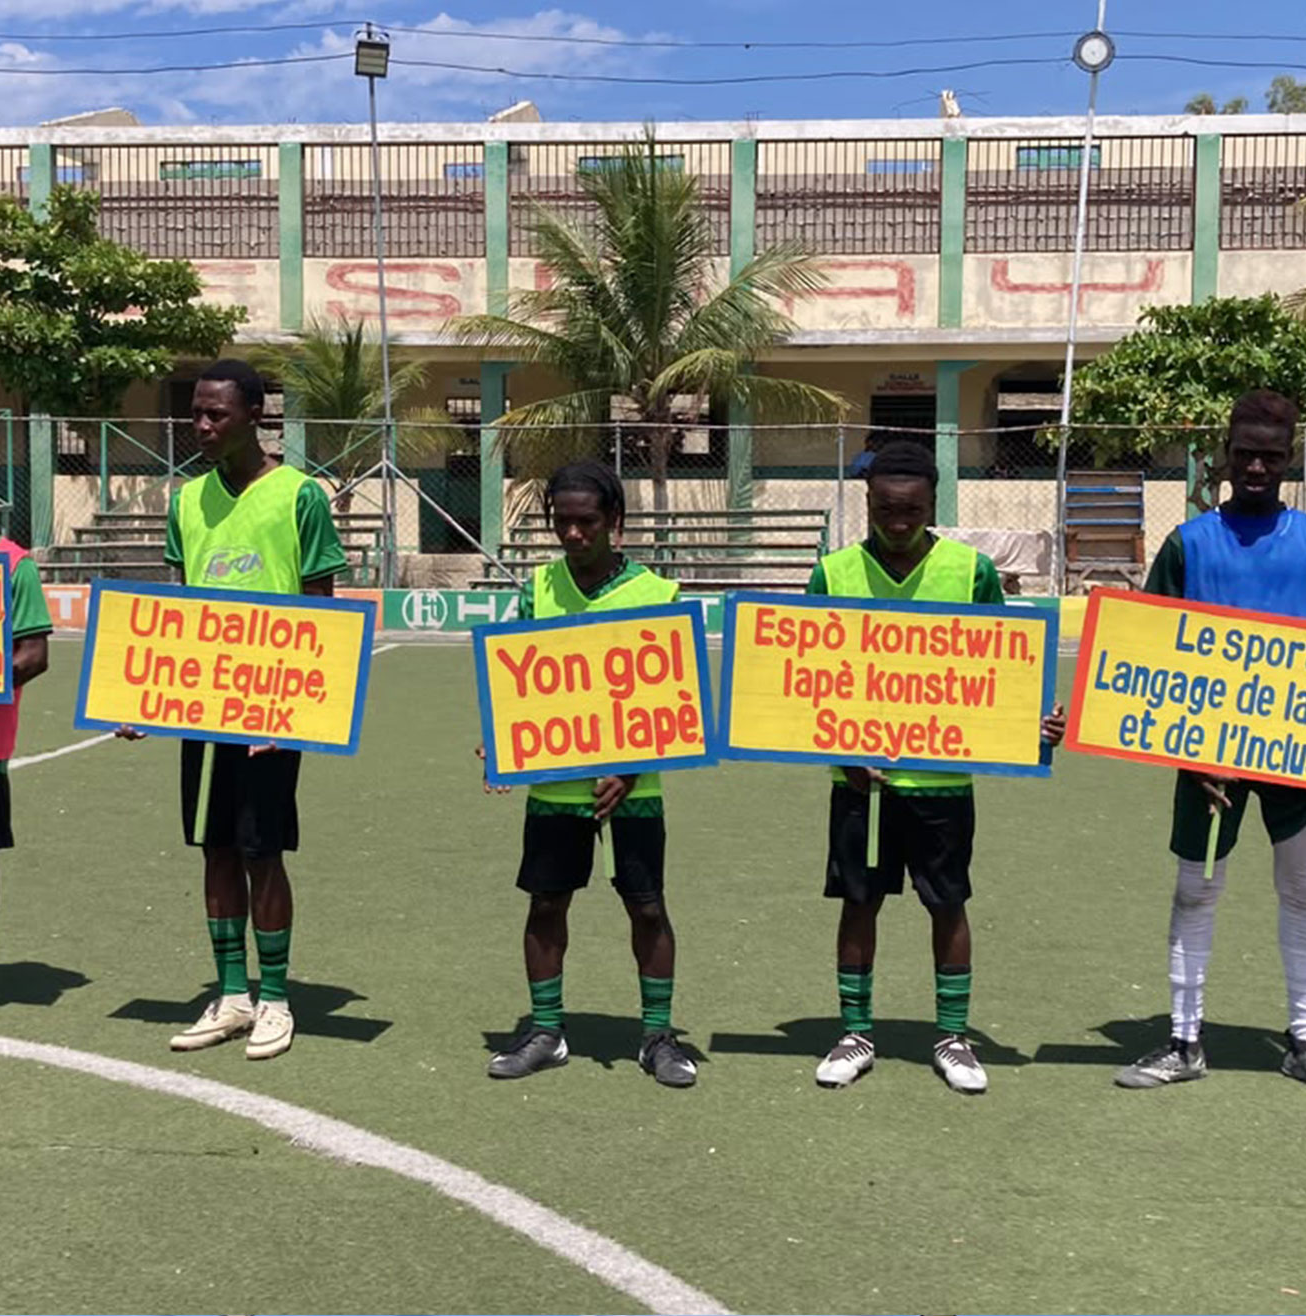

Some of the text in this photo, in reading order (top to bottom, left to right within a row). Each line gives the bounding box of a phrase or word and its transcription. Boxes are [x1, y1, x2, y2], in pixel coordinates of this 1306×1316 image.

[130, 597, 184, 638] Un
[198, 605, 324, 658] ballon,
[754, 607, 846, 659] Espò
[1175, 612, 1216, 657] Le
[124, 645, 328, 704] Une Equipe,
[496, 629, 684, 700] Yon gòl
[783, 659, 998, 708] lapè konstwi
[1094, 650, 1227, 715] Langage
[1236, 674, 1276, 717] de
[139, 690, 295, 734] Une Paix
[511, 690, 704, 770] pou lapè.
[812, 708, 972, 760] Sosyete.
[1119, 709, 1157, 751] et
[1164, 715, 1205, 758] de
